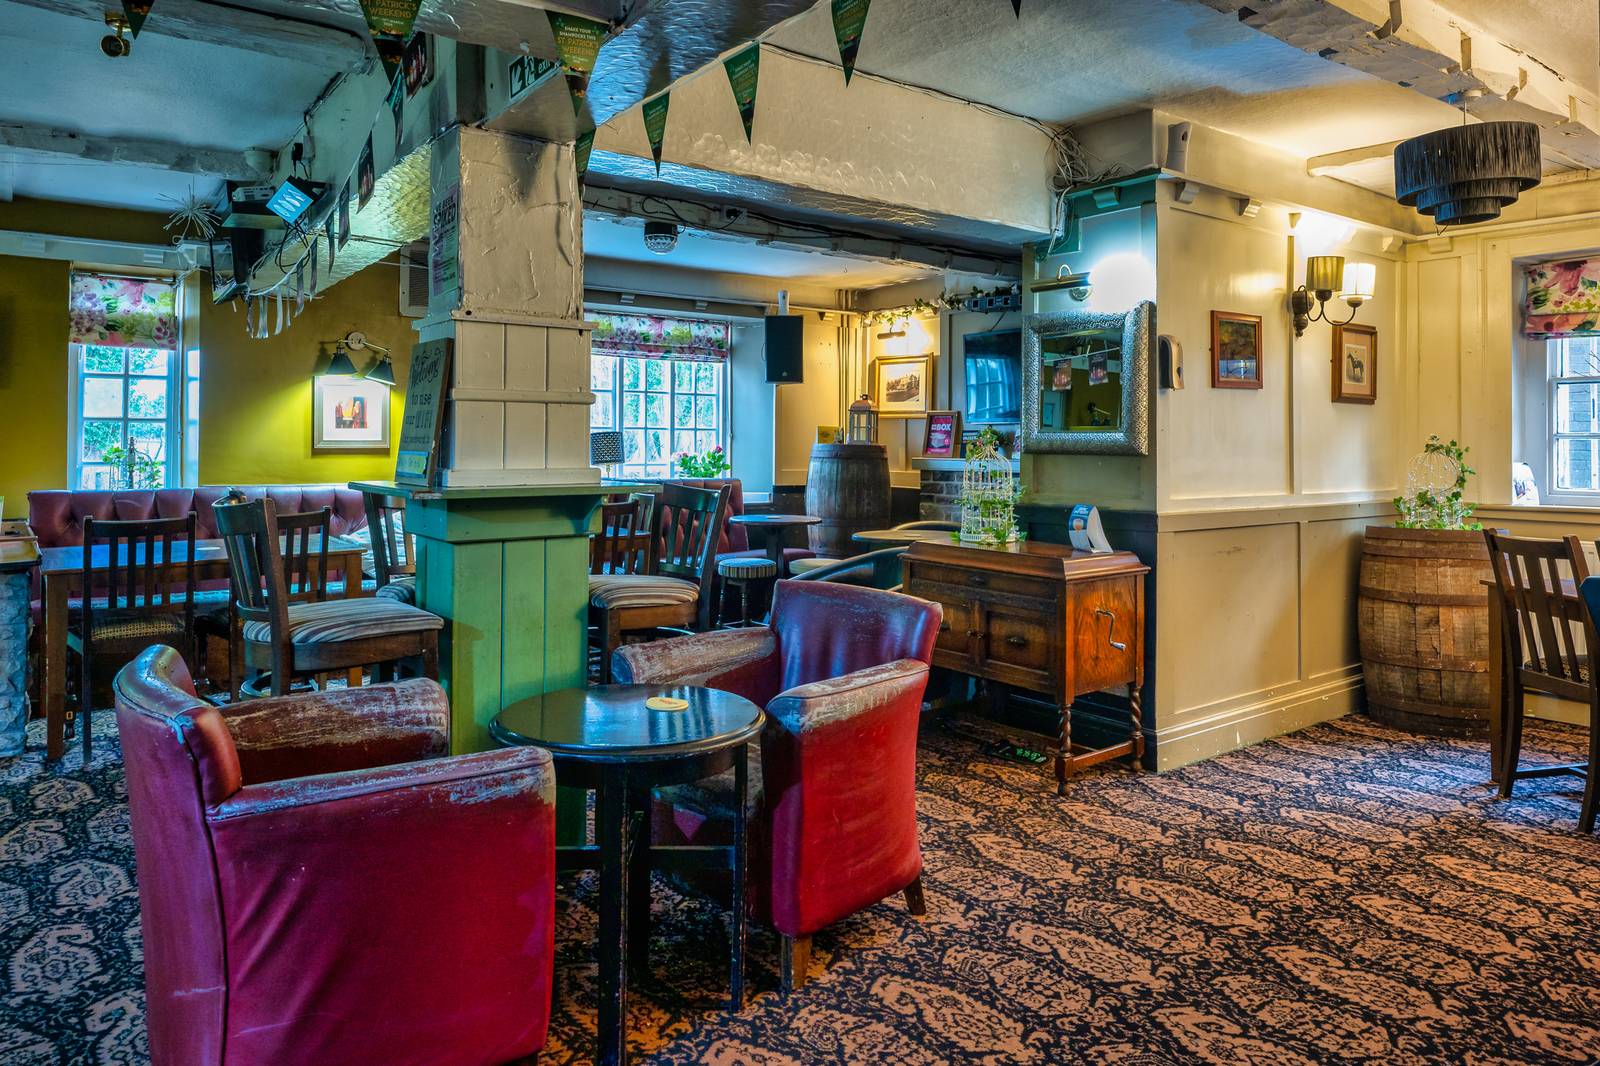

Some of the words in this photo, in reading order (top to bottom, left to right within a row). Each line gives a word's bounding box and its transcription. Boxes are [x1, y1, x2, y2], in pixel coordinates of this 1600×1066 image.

[368, 7, 412, 18] WEEKEND
[559, 31, 586, 39] SHAMROCKS
[563, 46, 595, 56] WEEKEND
